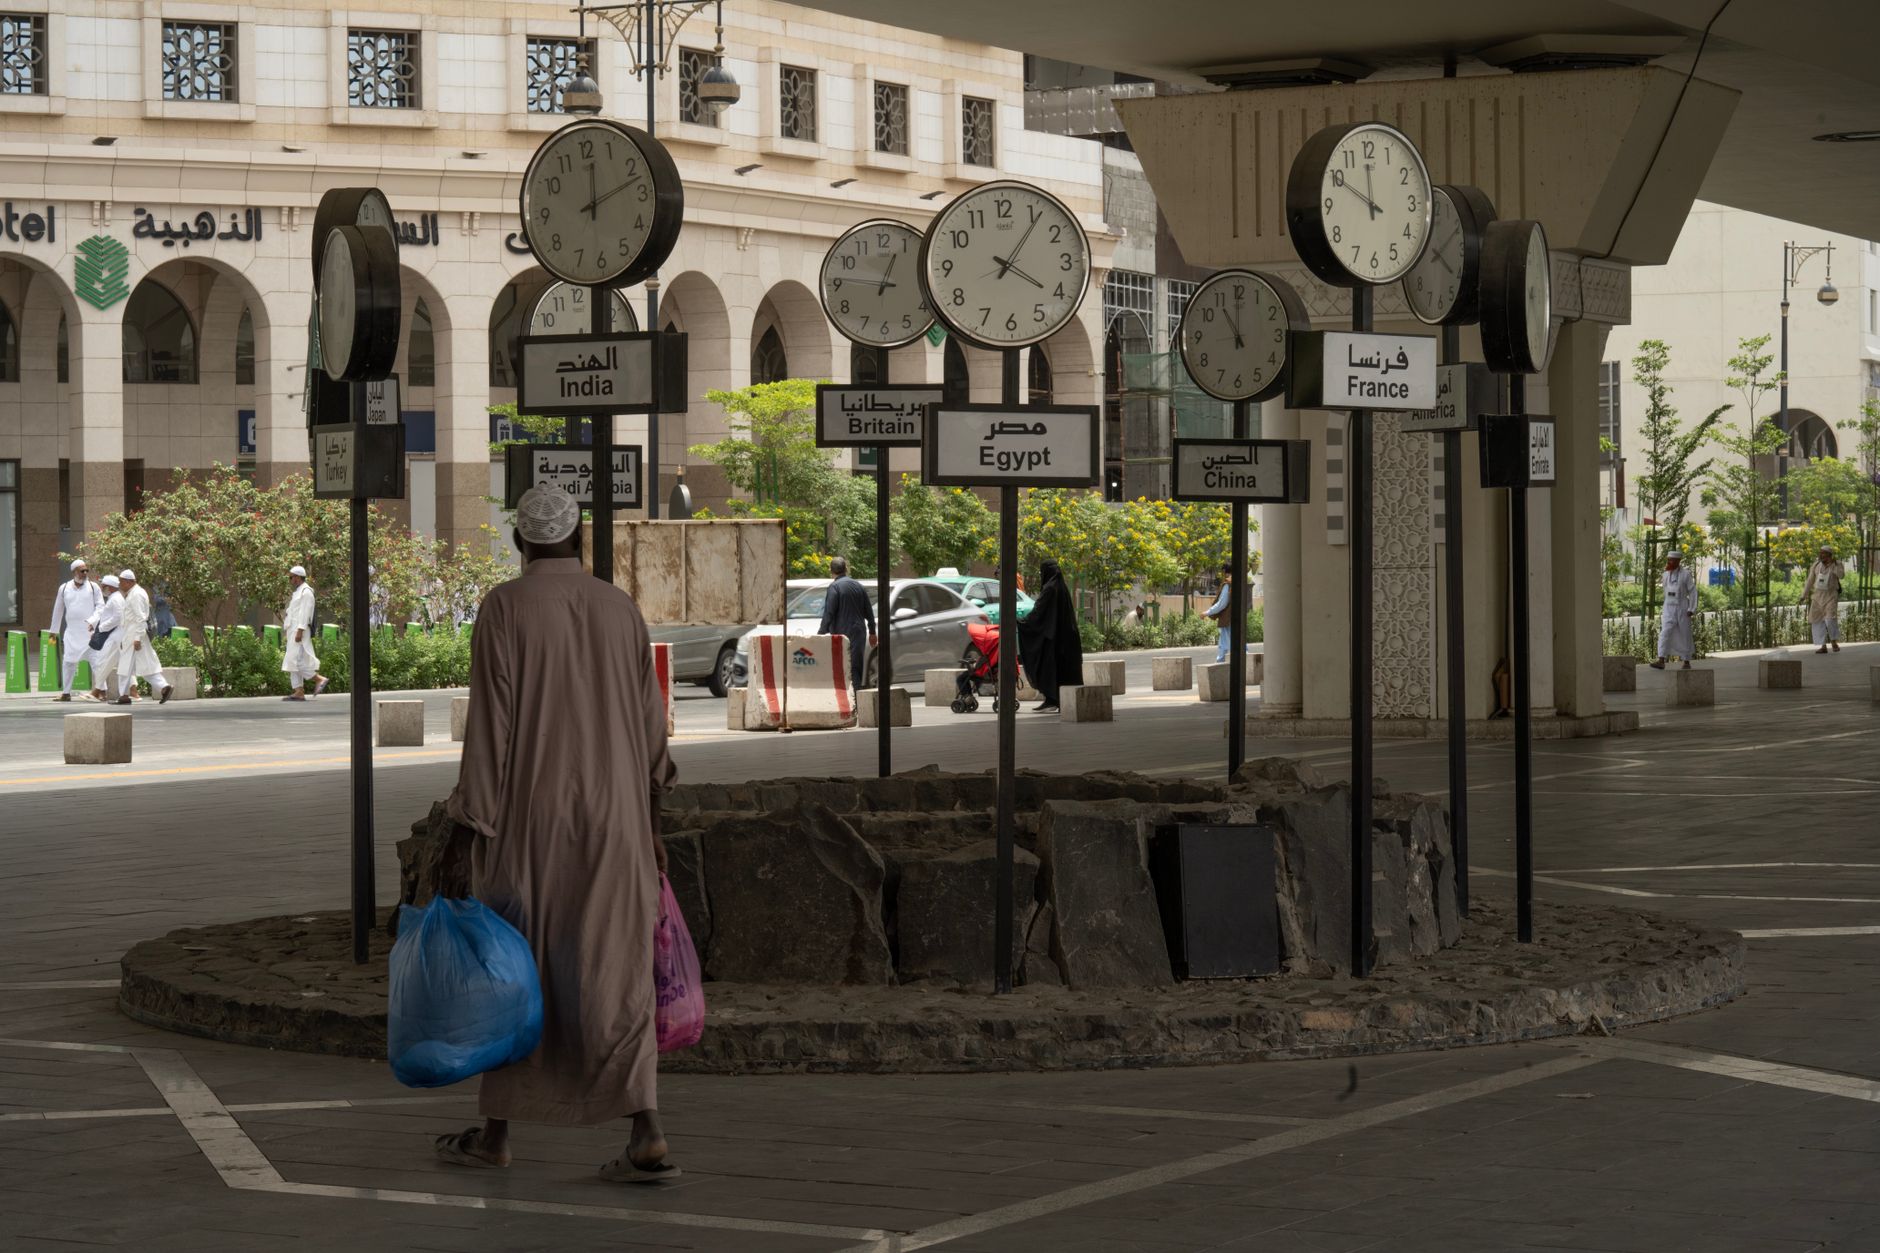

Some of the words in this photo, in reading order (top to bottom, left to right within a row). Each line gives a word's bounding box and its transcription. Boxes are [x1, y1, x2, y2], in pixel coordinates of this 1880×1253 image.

[578, 140, 594, 159] 12
[605, 142, 613, 160] 1
[1362, 141, 1375, 159] 12
[1384, 147, 1390, 165] 1
[557, 154, 572, 174] 11
[625, 158, 637, 177] 2
[1343, 151, 1355, 168] 11
[1330, 169, 1344, 187] 10
[1400, 167, 1409, 185] 2
[545, 177, 561, 196] 10
[637, 184, 648, 202] 3
[994, 200, 1012, 218] 12
[1325, 198, 1333, 215] 9
[1408, 195, 1416, 212] 3
[0, 202, 55, 243] tel
[541, 207, 550, 225] 9
[634, 214, 645, 231] 4
[968, 210, 984, 229] 11
[1027, 205, 1035, 223] 1
[133, 207, 262, 248] الذهبية
[1049, 225, 1061, 243] 2
[1333, 226, 1342, 243] 8
[1403, 222, 1412, 240] 4
[552, 233, 562, 251] 8
[619, 238, 629, 256] 5
[856, 241, 868, 255] 11
[877, 234, 890, 248] 12
[902, 238, 907, 253] 1
[950, 230, 969, 248] 10
[574, 249, 584, 268] 7
[597, 251, 606, 269] 6
[1351, 246, 1360, 263] 7
[1370, 251, 1379, 269] 6
[1389, 243, 1398, 261] 5
[841, 256, 855, 270] 10
[942, 260, 953, 278] 9
[1060, 253, 1072, 271] 3
[833, 277, 842, 291] 9
[1053, 281, 1065, 300] 4
[1233, 285, 1244, 299] 12
[553, 296, 565, 312] 11
[571, 288, 584, 304] 12
[953, 288, 965, 306] 8
[1215, 293, 1225, 307] 11
[1255, 290, 1259, 305] 1
[840, 300, 850, 314] 8
[918, 299, 927, 313] 4
[1033, 304, 1045, 322] 5
[1202, 308, 1214, 322] 10
[1268, 306, 1277, 321] 2
[541, 312, 555, 328] 10
[860, 316, 869, 330] 7
[903, 315, 912, 329] 5
[979, 308, 991, 326] 7
[1005, 313, 1017, 331] 6
[880, 321, 889, 335] 6
[1194, 330, 1202, 344] 9
[1274, 328, 1283, 343] 3
[556, 346, 618, 373] الهند
[1200, 353, 1208, 367] 8
[1268, 351, 1276, 366] 4
[1348, 344, 1409, 374] فرنسا
[1217, 369, 1225, 384] 7
[1234, 374, 1242, 388] 6
[1253, 368, 1261, 382] 5
[560, 376, 613, 398] India
[1348, 375, 1409, 398] France
[841, 393, 922, 417] بريطانيا
[1412, 401, 1455, 421] America
[368, 406, 387, 424] Japan
[849, 418, 914, 434] Britain
[983, 421, 1048, 441] مصر
[326, 436, 347, 460] تركيا
[538, 453, 630, 479] السودية
[979, 446, 1051, 471] Egypt
[1202, 446, 1259, 470] الصين
[325, 462, 347, 484] Turkey
[1204, 471, 1257, 488] China
